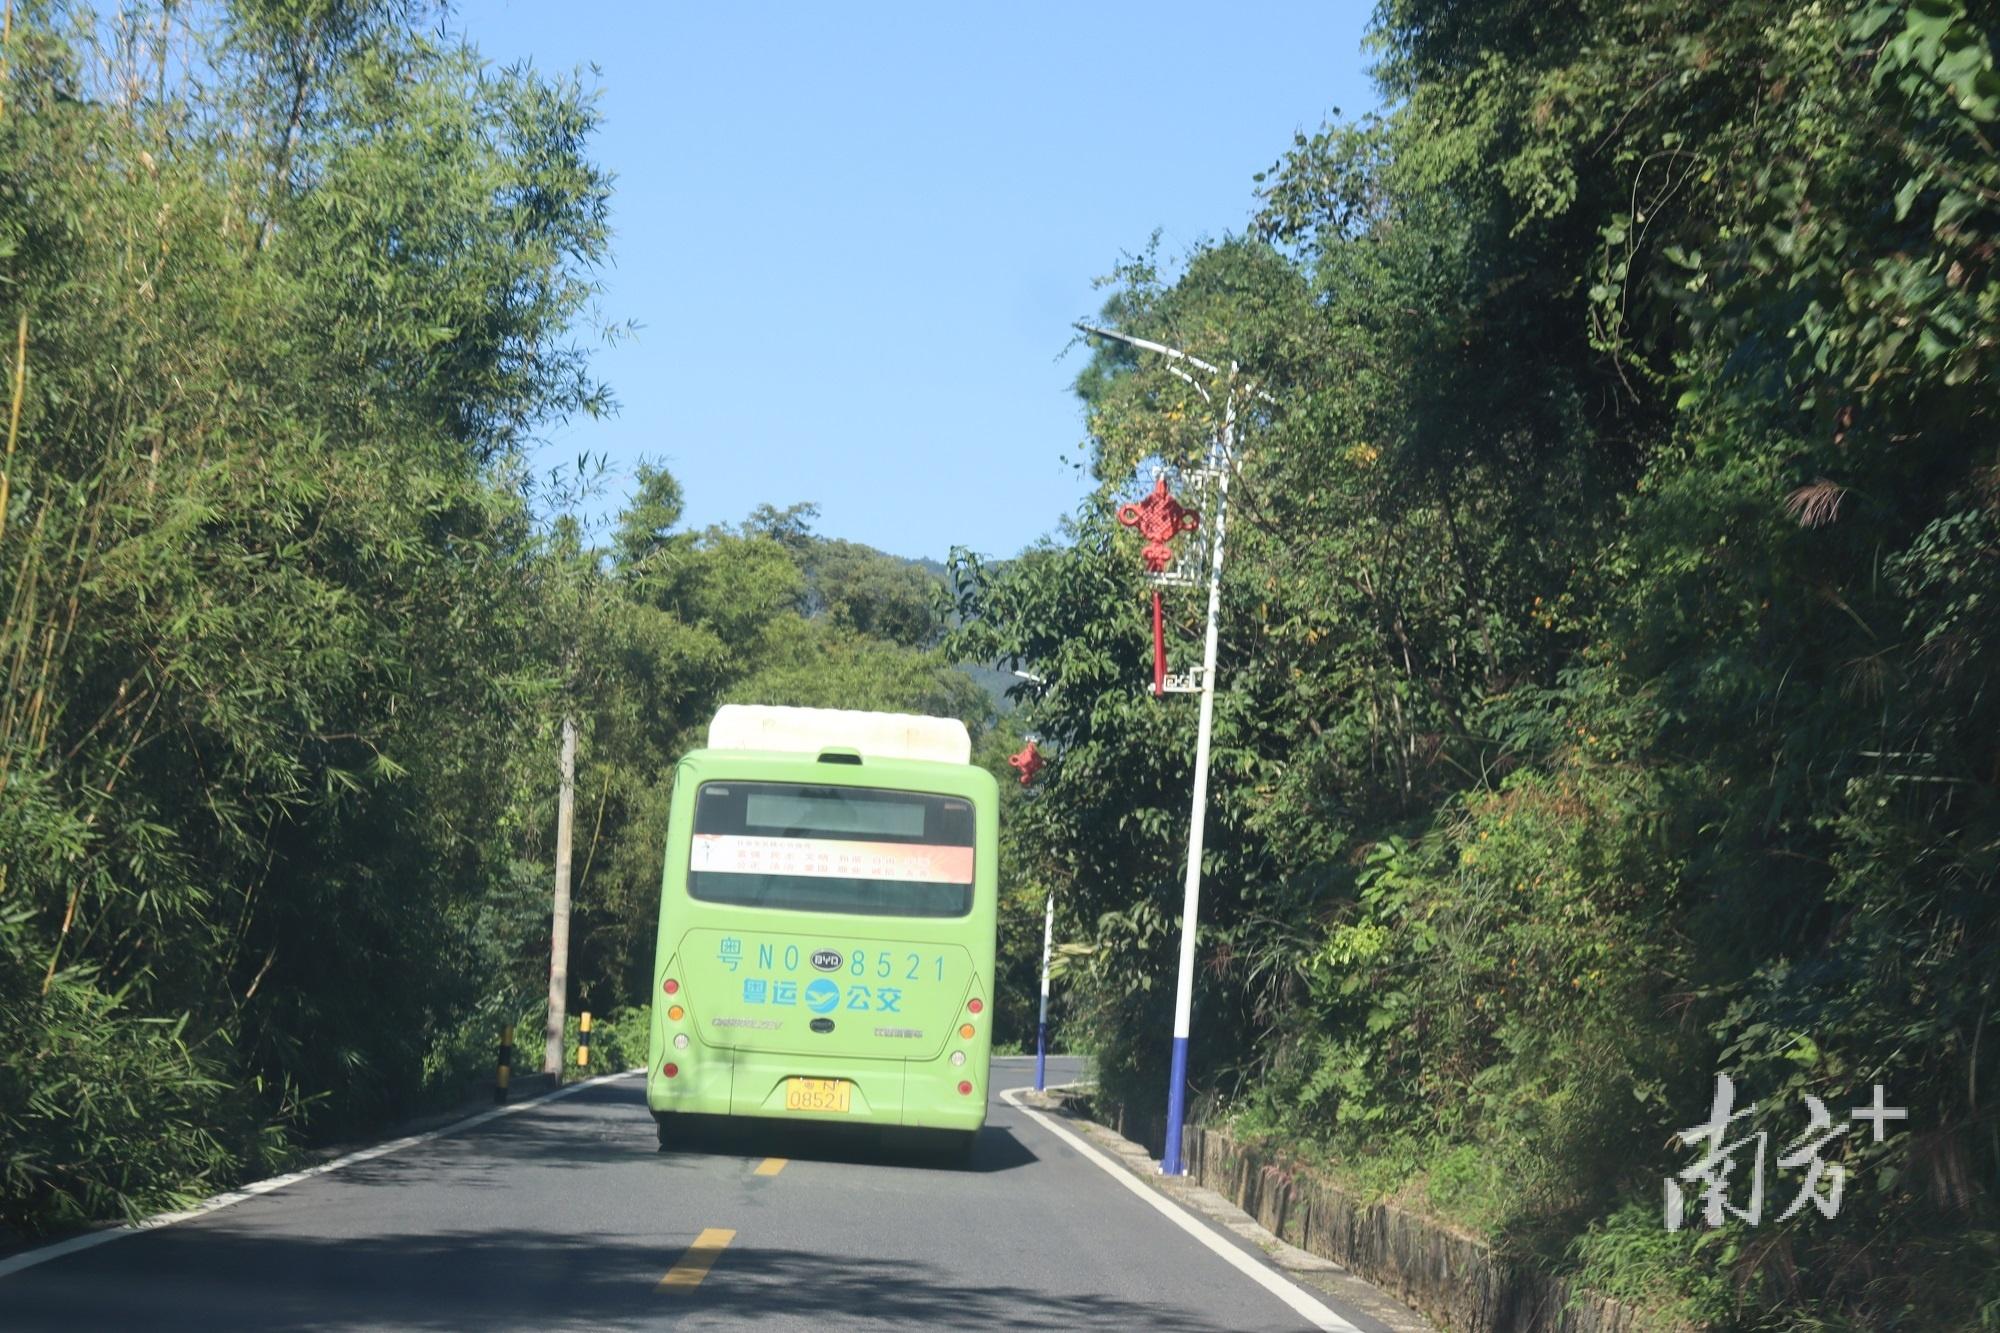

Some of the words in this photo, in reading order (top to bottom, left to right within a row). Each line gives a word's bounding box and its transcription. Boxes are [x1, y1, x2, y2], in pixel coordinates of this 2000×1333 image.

[814, 954, 839, 966] BYD
[846, 985, 902, 1012] 公交
[790, 1091, 843, 1109] 08521
